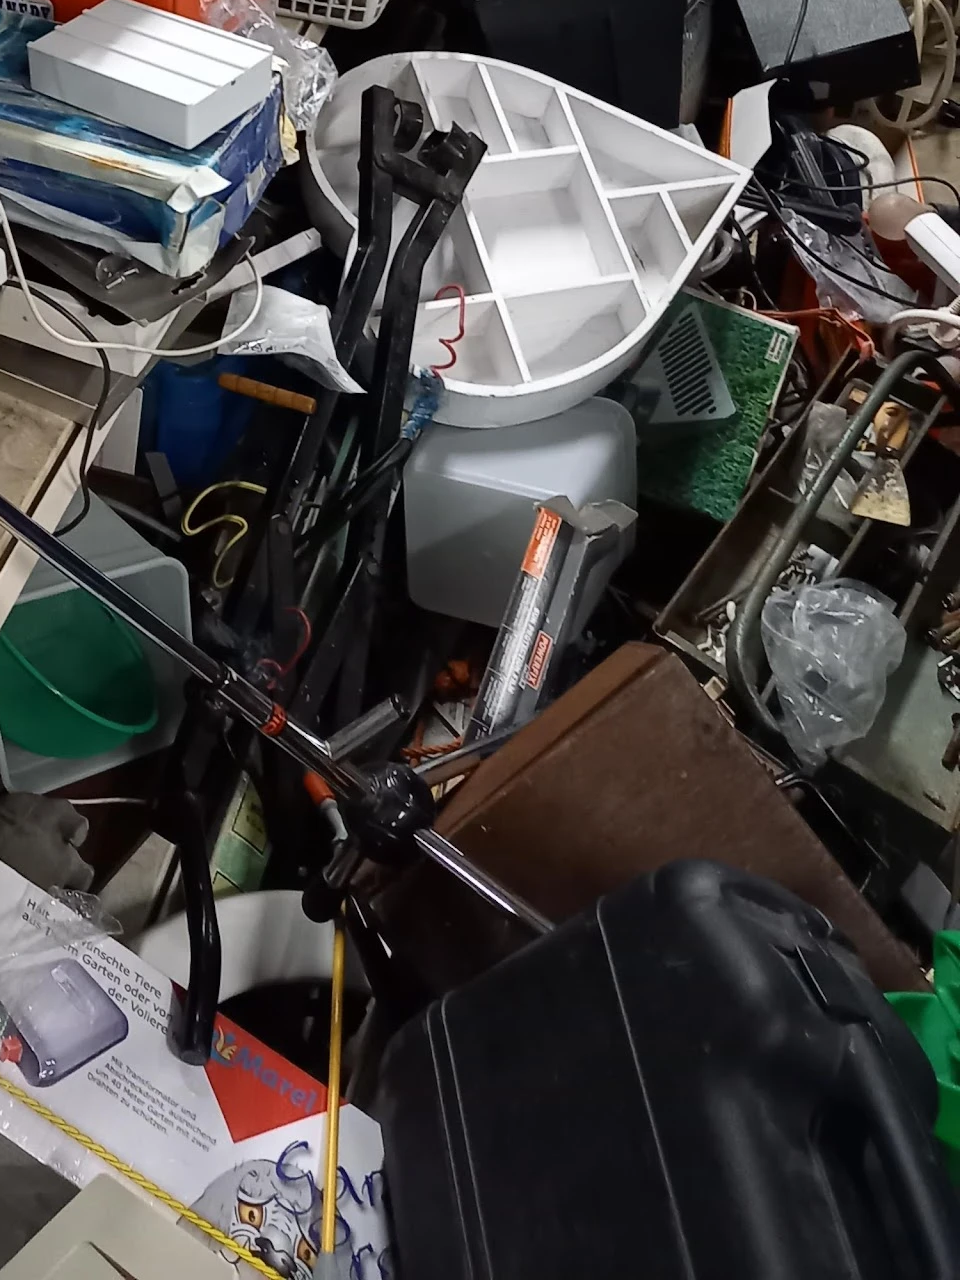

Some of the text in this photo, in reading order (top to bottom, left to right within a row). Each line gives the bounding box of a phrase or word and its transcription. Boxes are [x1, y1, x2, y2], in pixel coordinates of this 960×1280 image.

[526, 634, 551, 686] POWERFIX
[82, 953, 122, 986] Garten
[124, 982, 152, 1004] oder
[134, 971, 163, 1000] Tiere
[107, 986, 169, 1036] der Voliere
[111, 1055, 197, 1121] Mit Transformator und
[120, 1096, 131, 1108] zu
[234, 1046, 319, 1113] Marel
[95, 1067, 210, 1153] um 40 Meter Garten mit zwei
